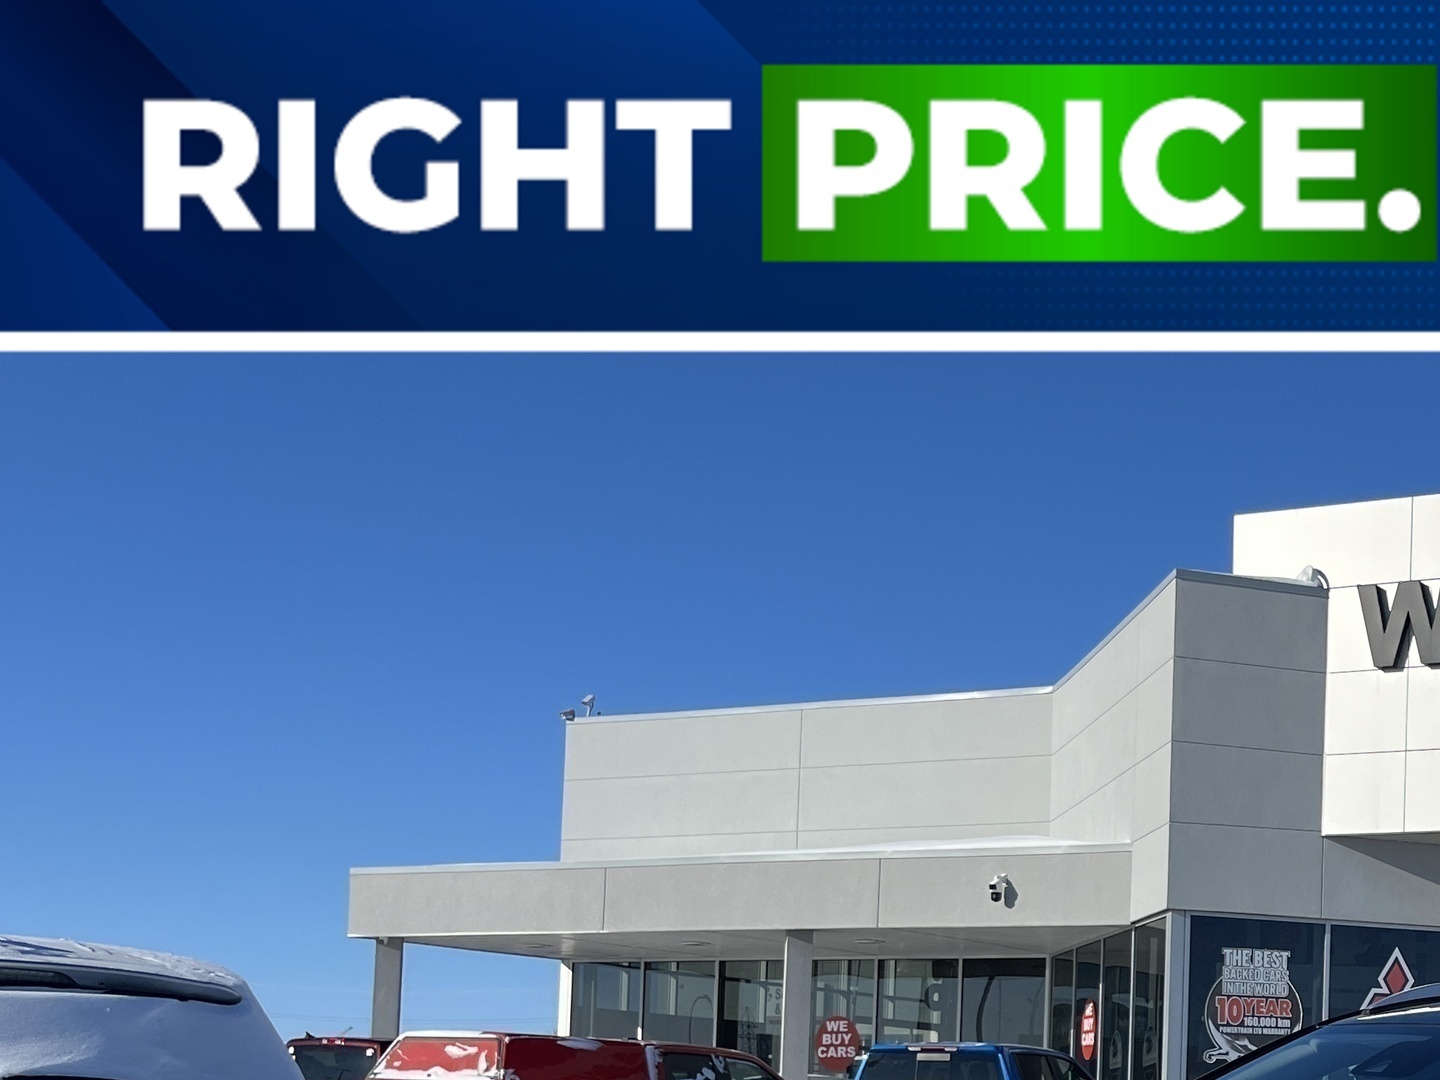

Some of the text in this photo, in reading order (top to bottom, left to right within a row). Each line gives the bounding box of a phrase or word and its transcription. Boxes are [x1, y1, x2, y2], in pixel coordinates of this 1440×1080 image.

[1223, 949, 1290, 968] THE BEST
[1224, 968, 1289, 981] BACKED CARS
[1223, 981, 1288, 996] IN THE WORLD
[1215, 996, 1292, 1025] 10 YEAR
[826, 1021, 848, 1032] WE
[1083, 1018, 1094, 1032] BUY
[1243, 1017, 1291, 1028] 160,000 km
[822, 1034, 852, 1045] BUY
[1081, 1032, 1095, 1046] CARS
[817, 1046, 856, 1058] CARS
